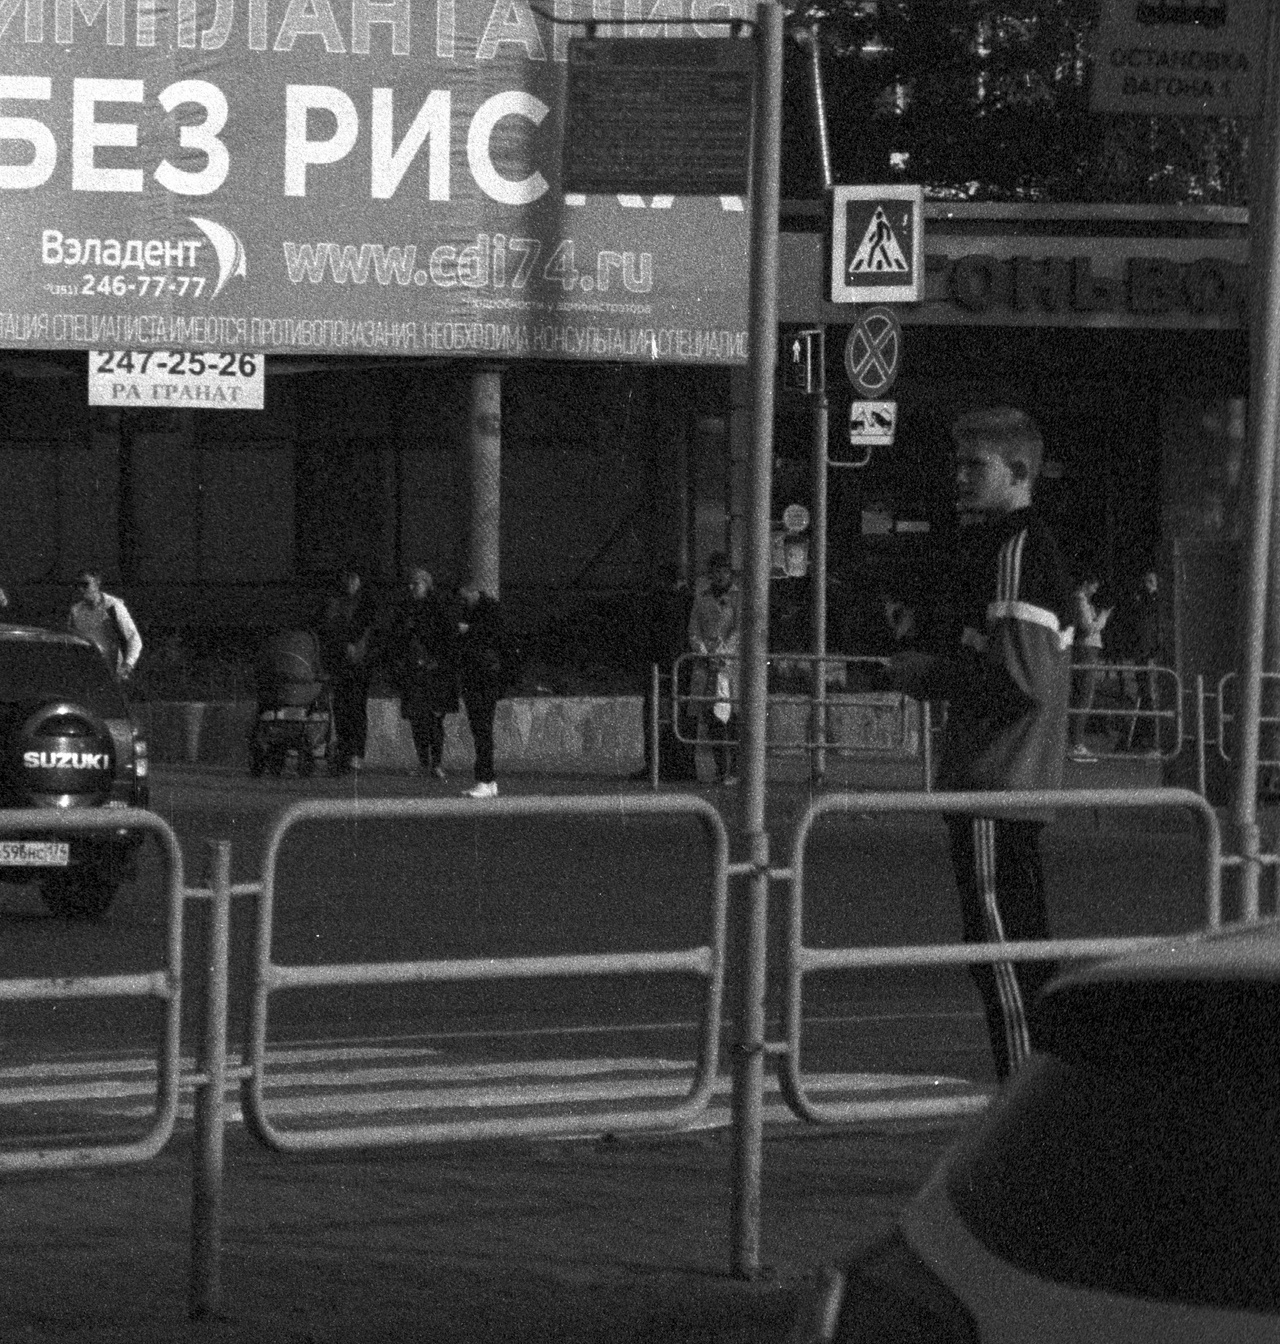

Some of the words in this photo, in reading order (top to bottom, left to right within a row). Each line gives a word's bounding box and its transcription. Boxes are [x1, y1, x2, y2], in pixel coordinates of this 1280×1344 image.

[284, 85, 744, 212] РИС
[41, 229, 202, 270] Вэладент
[282, 233, 653, 294] www.cdi74.ru
[81, 274, 206, 299] 246-77-77
[658, 328, 749, 359] СПЕЦИАЛИС
[97, 351, 257, 378] 247-25-26
[111, 383, 142, 400] РА
[151, 384, 243, 402] ГРАНАТ
[23, 751, 110, 770] SUZUKI
